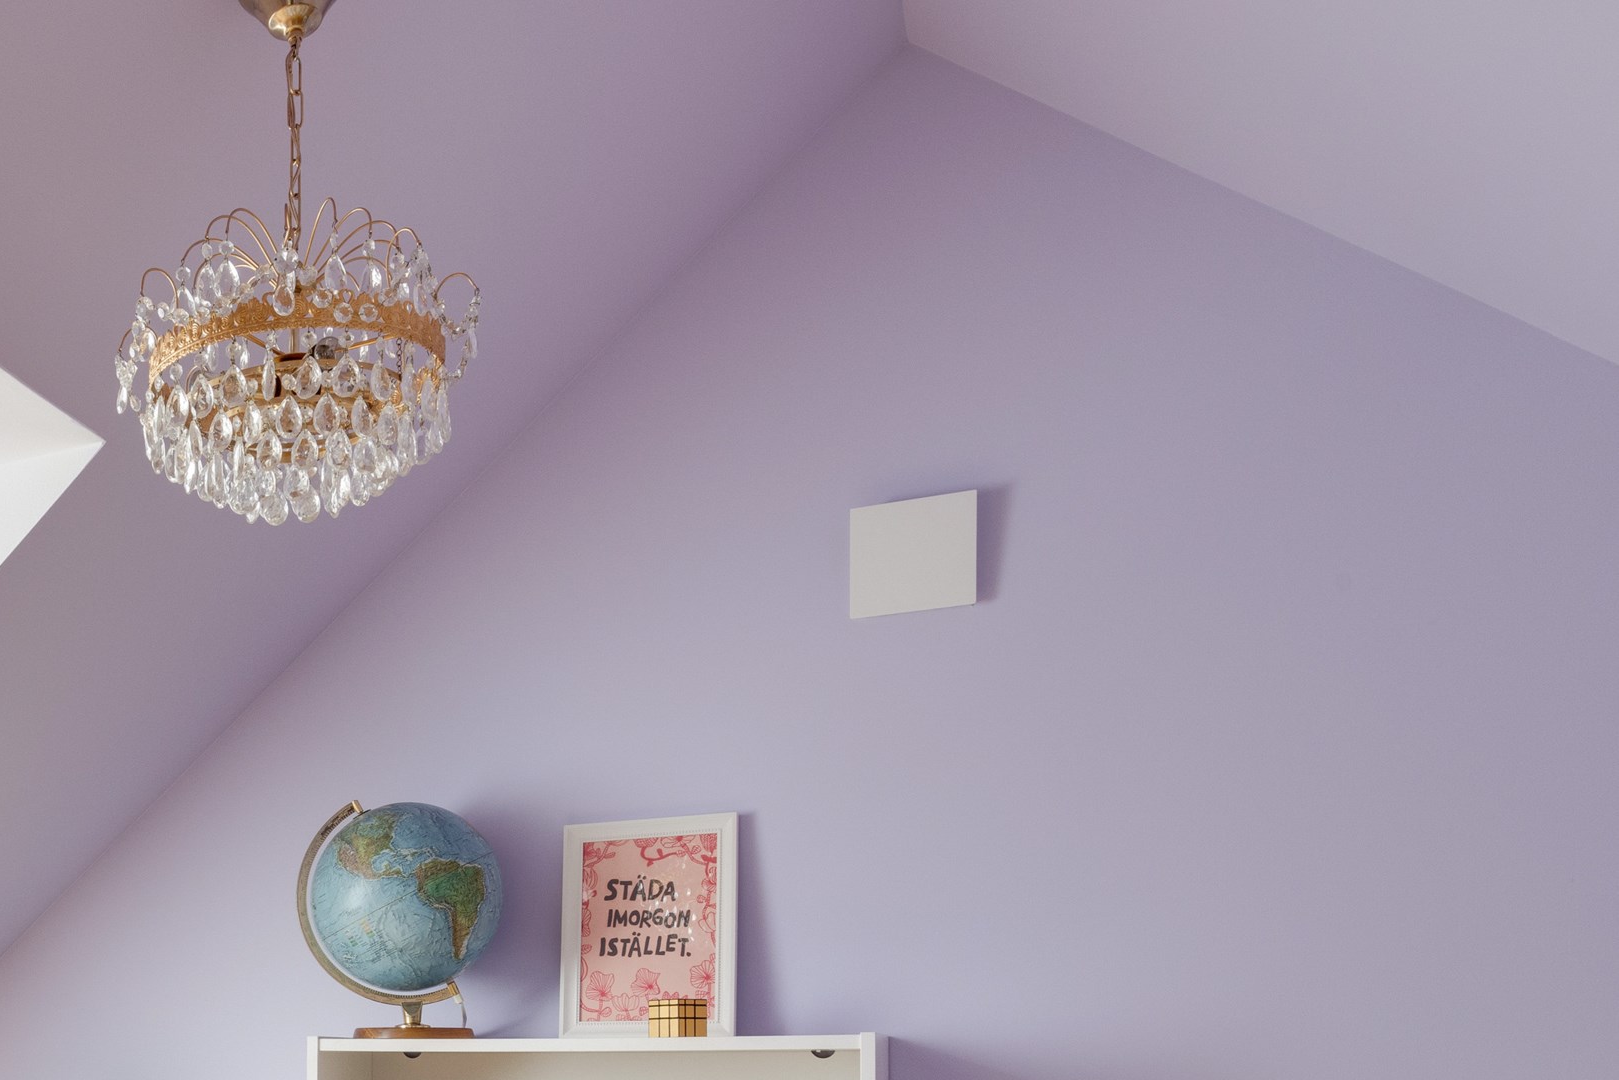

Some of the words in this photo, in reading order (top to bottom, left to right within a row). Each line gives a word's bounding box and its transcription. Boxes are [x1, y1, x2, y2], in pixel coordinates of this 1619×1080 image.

[604, 875, 676, 901] STÄDA
[607, 909, 691, 928] IMORGON
[600, 932, 691, 957] ISTÄLLET.
